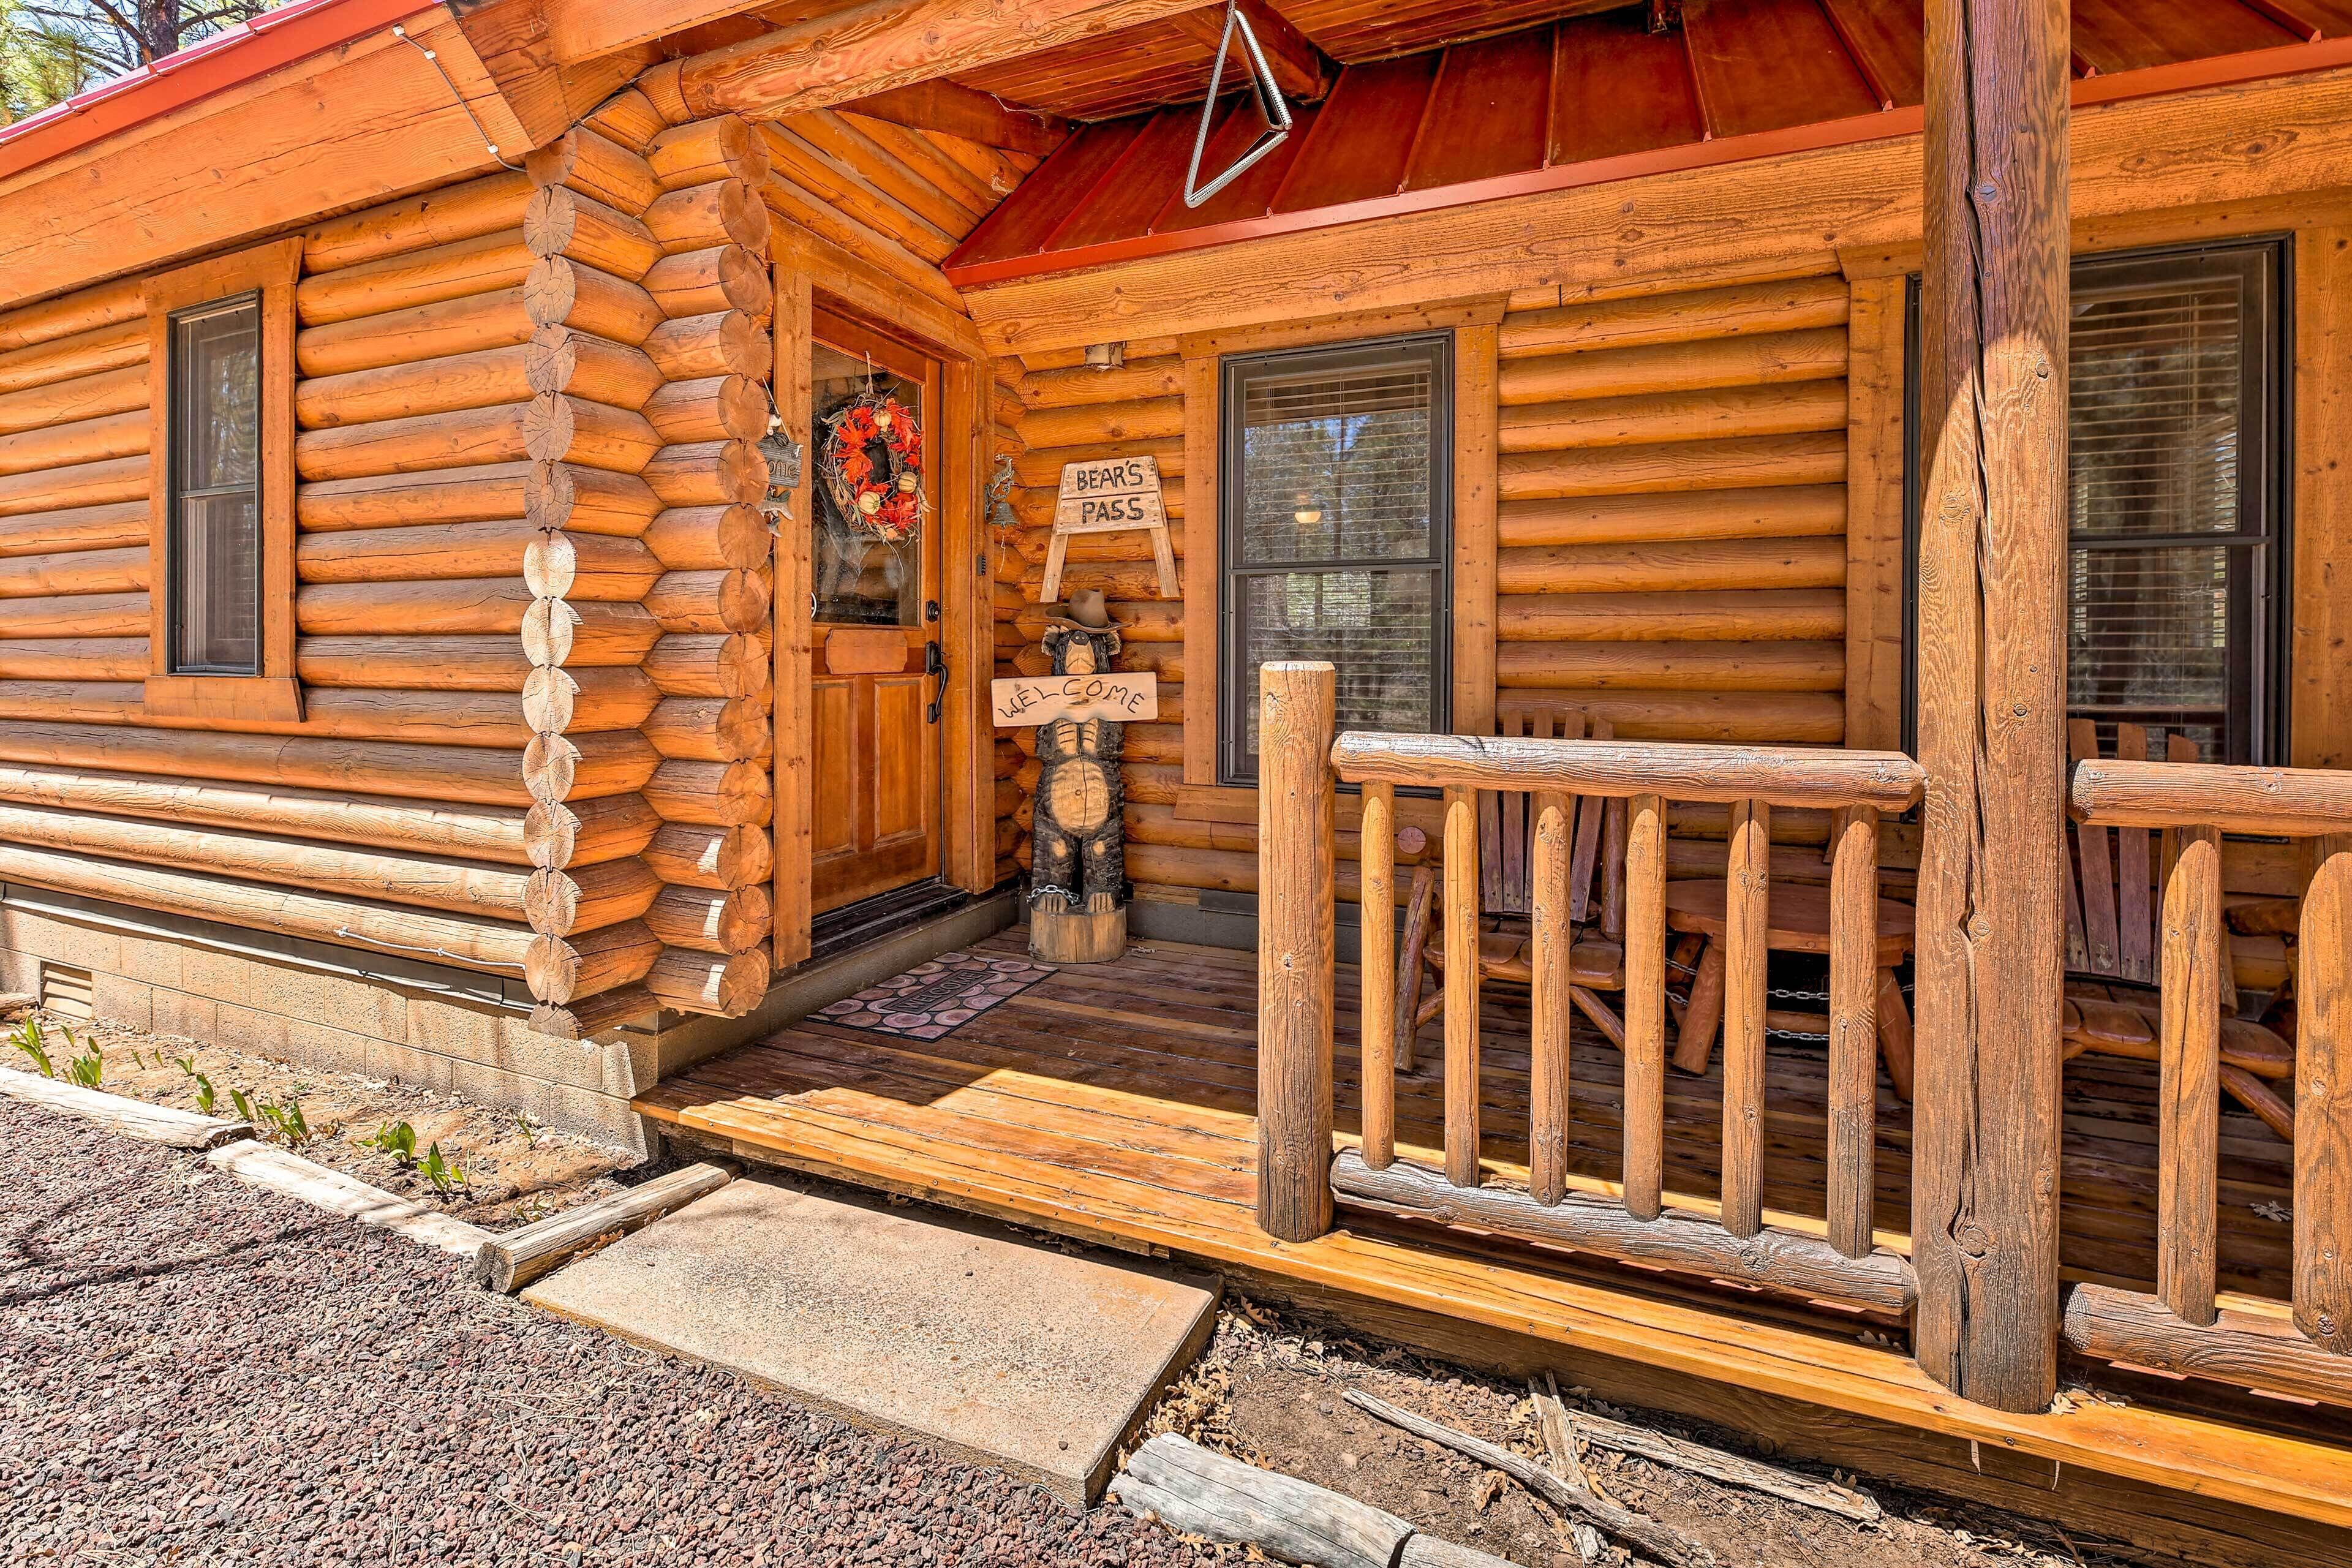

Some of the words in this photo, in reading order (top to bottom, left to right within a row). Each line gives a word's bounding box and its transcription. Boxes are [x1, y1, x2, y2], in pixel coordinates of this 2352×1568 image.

[1076, 460, 1144, 491] BEAR'S
[1082, 497, 1144, 524] PASS
[998, 679, 1145, 718] WELCOME
[897, 971, 982, 1009] WELCOME
